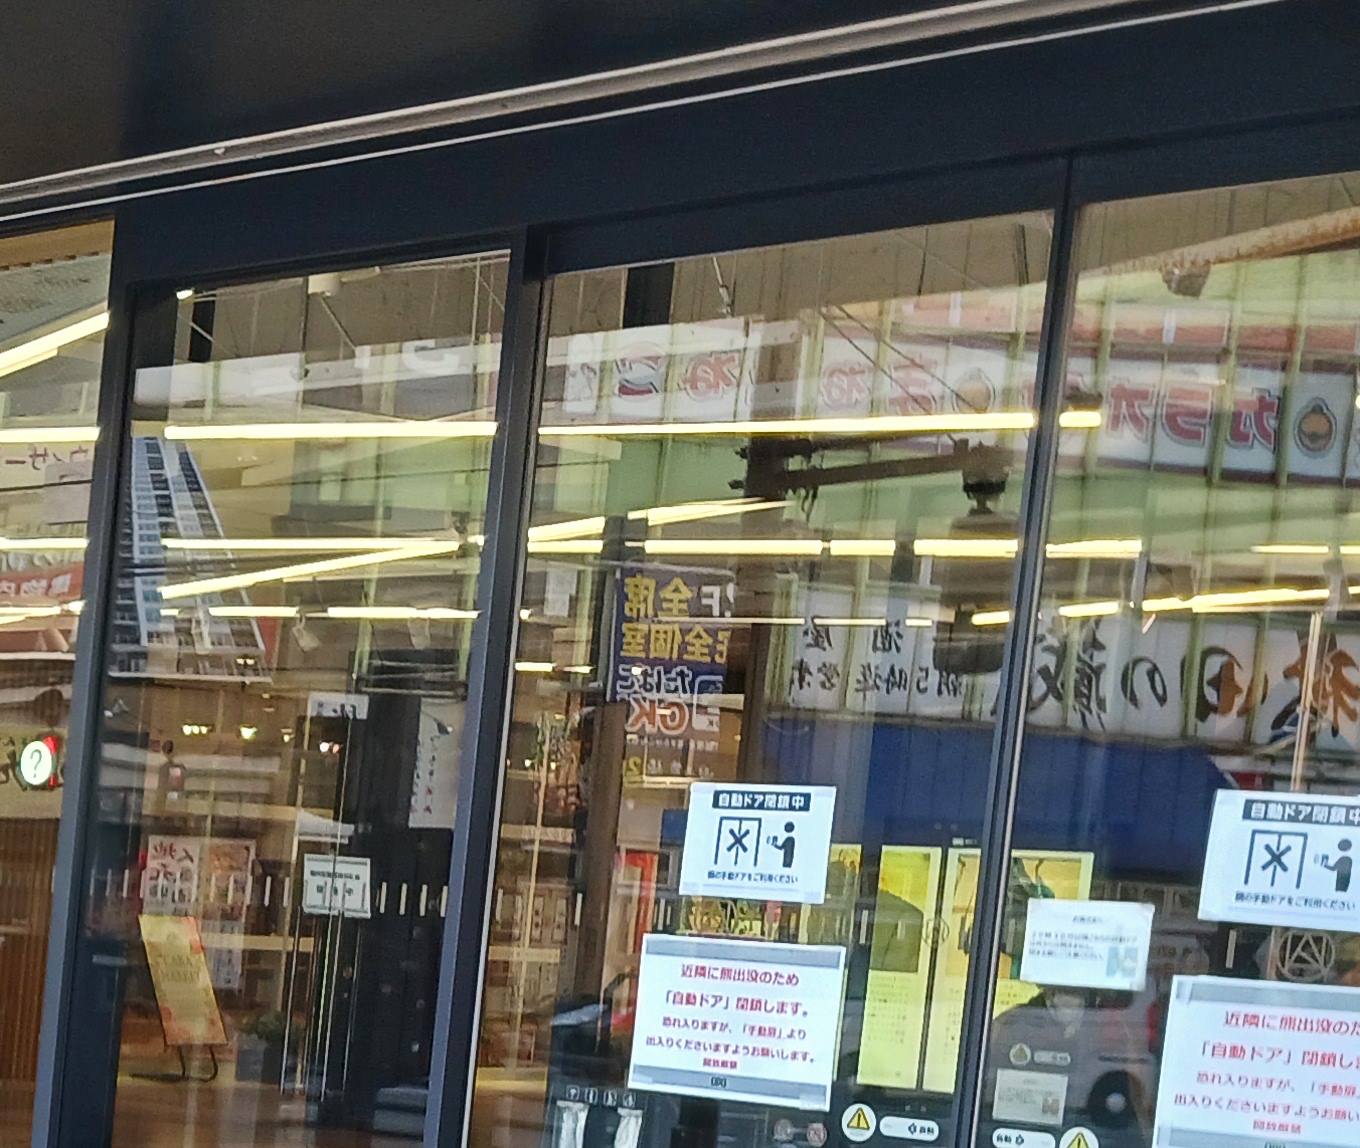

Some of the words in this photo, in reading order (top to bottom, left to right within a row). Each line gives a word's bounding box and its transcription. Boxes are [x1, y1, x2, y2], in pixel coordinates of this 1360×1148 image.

[718, 792, 805, 810] 自動ドア閉鎖中
[1251, 802, 1360, 825] 自動ドア閉鎖中
[681, 963, 799, 987] 近隣に熊出没のため
[666, 990, 809, 1017] 「自動ドア」閉鎖します。
[1196, 1071, 1360, 1098] 恐れ入りますが、「手動扉
